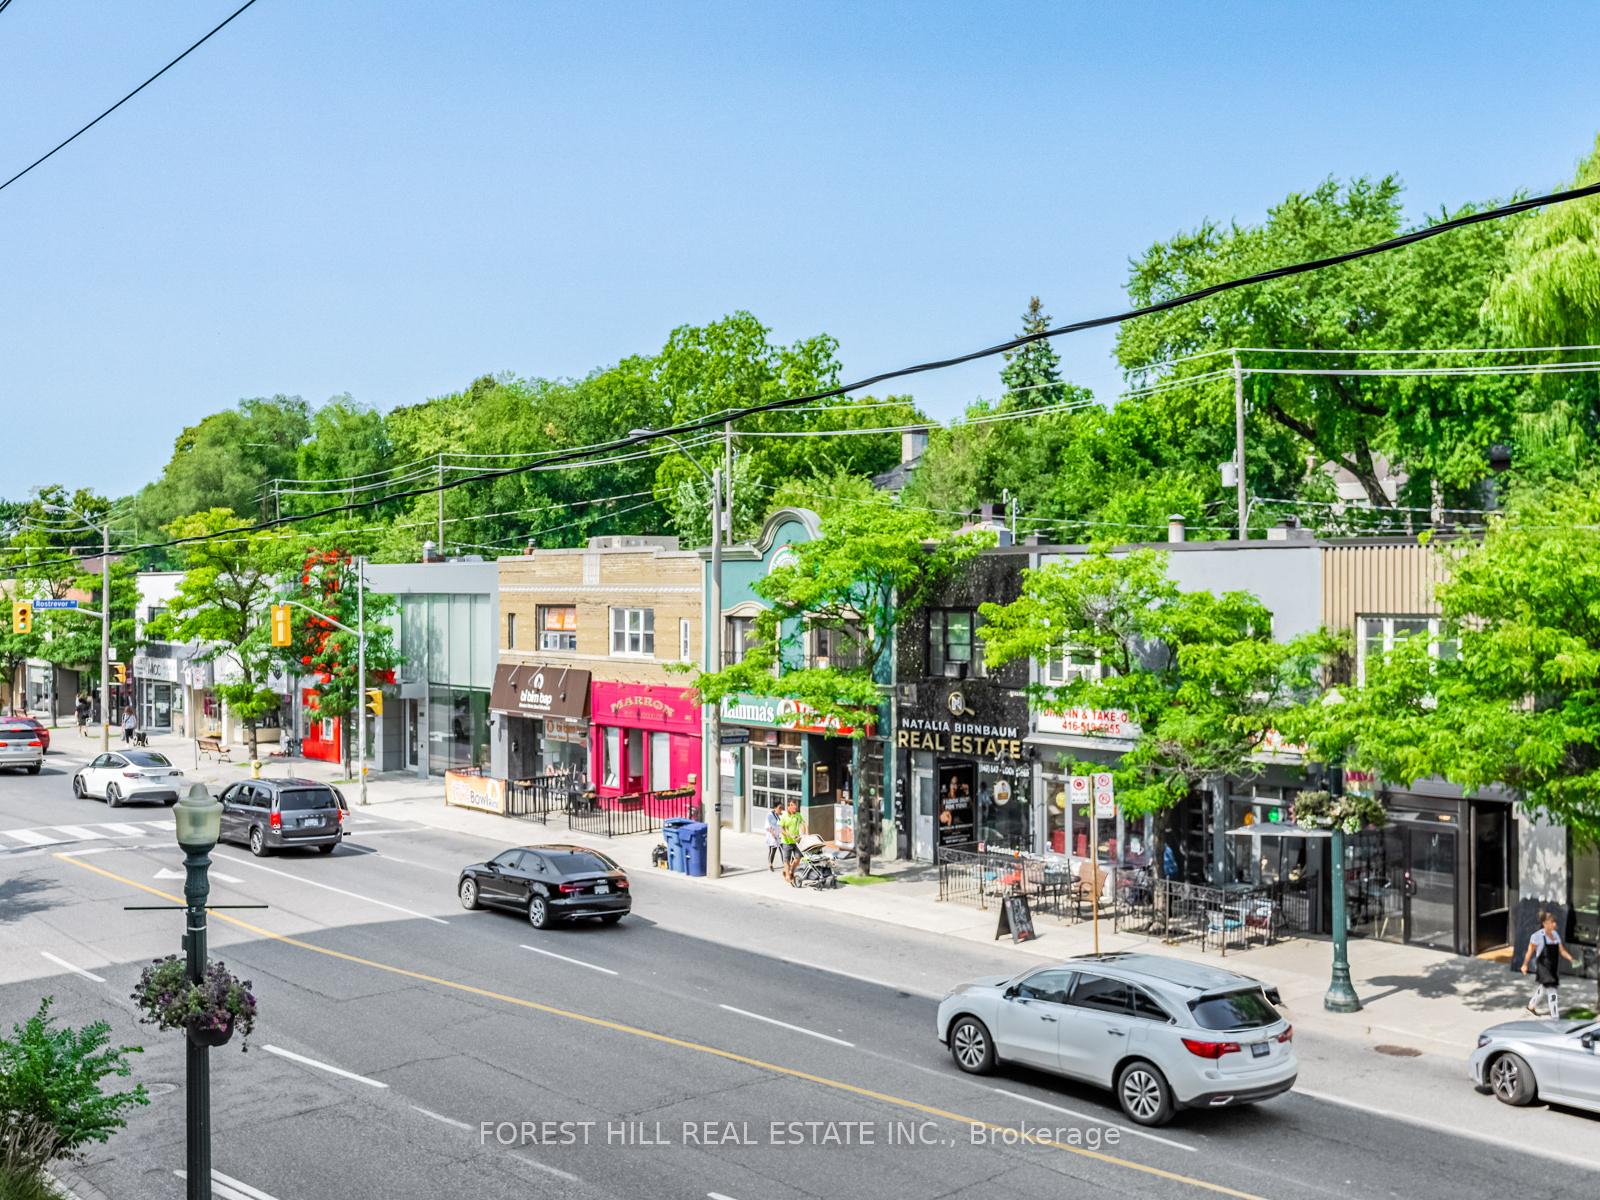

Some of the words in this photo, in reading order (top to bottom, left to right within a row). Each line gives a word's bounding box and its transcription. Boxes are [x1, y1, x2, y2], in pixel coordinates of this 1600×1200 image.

[610, 696, 675, 718] MARRON
[1081, 711, 1088, 720] &
[902, 718, 950, 732] NATALIA
[954, 722, 1017, 738] BIRNBAUM
[898, 730, 945, 751] REAL
[950, 735, 1021, 759] ESTATE
